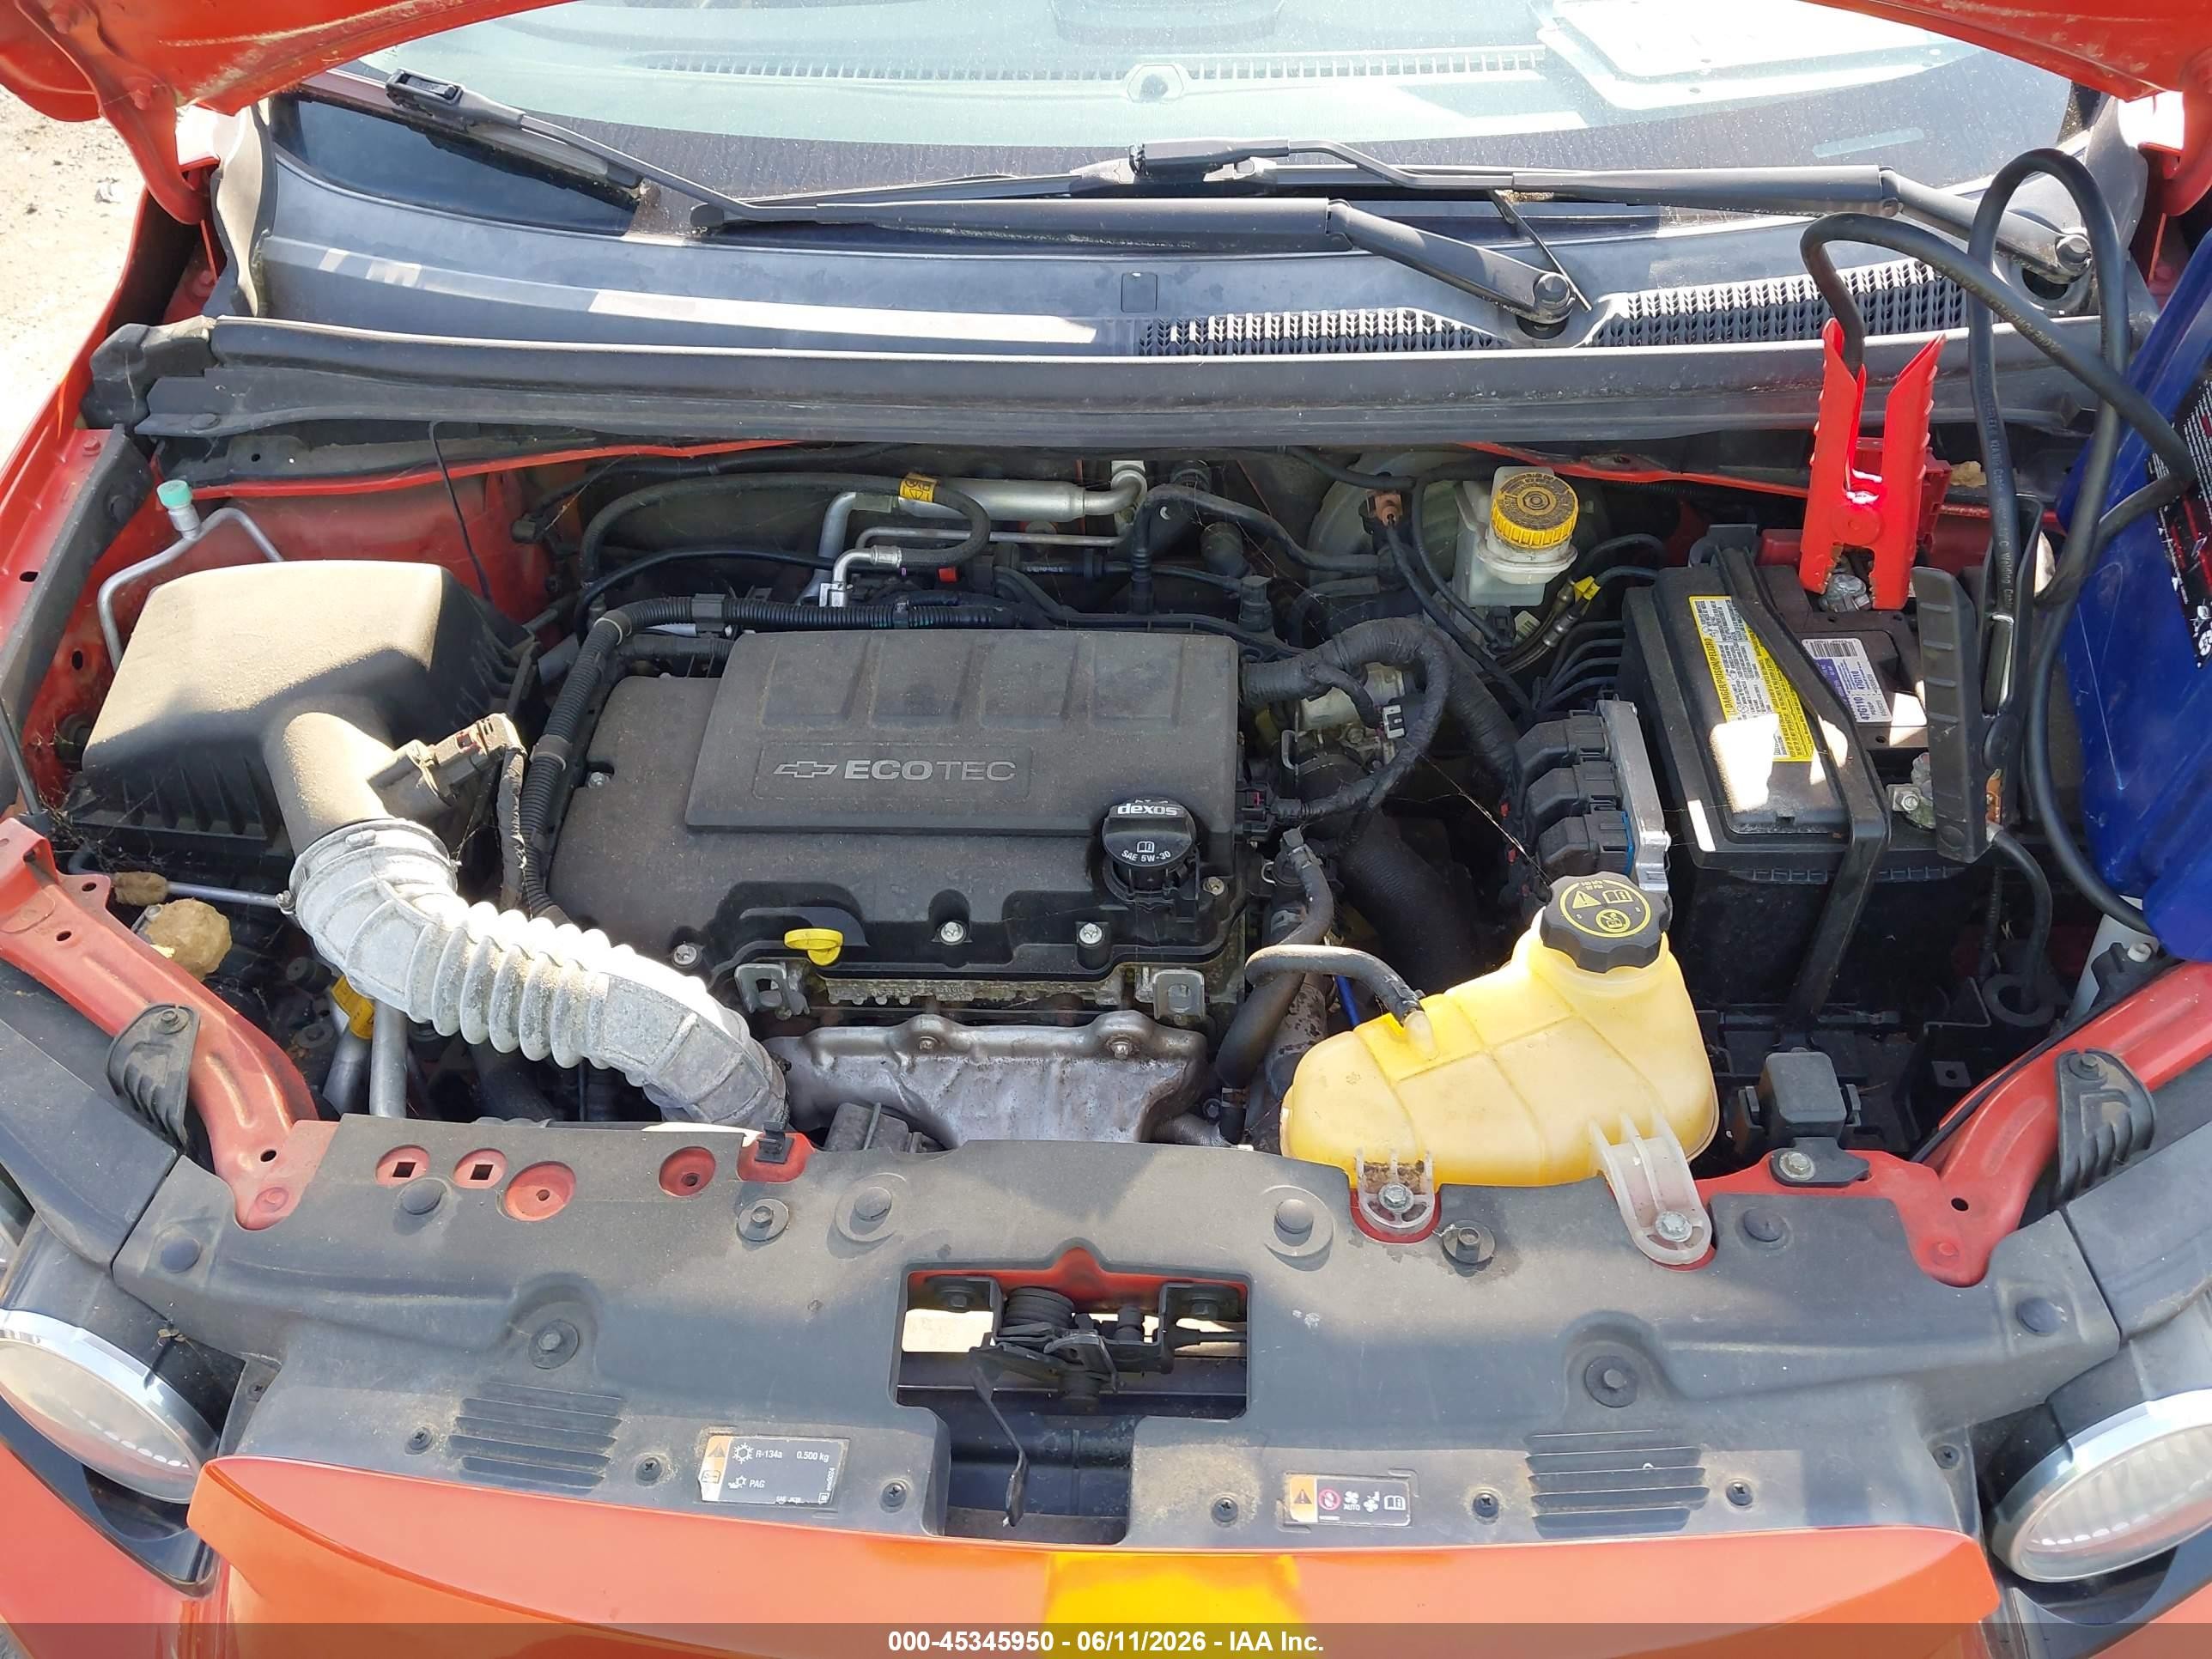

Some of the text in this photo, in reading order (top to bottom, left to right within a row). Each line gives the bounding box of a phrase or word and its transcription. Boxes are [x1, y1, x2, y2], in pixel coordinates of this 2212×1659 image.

[844, 760, 1017, 781] ECOTEC
[1117, 803, 1178, 816] dexos
[1121, 850, 1171, 862] SAE 5W-30
[755, 1449, 830, 1463] R-134a 0.500 kg
[749, 1479, 766, 1489] PAG
